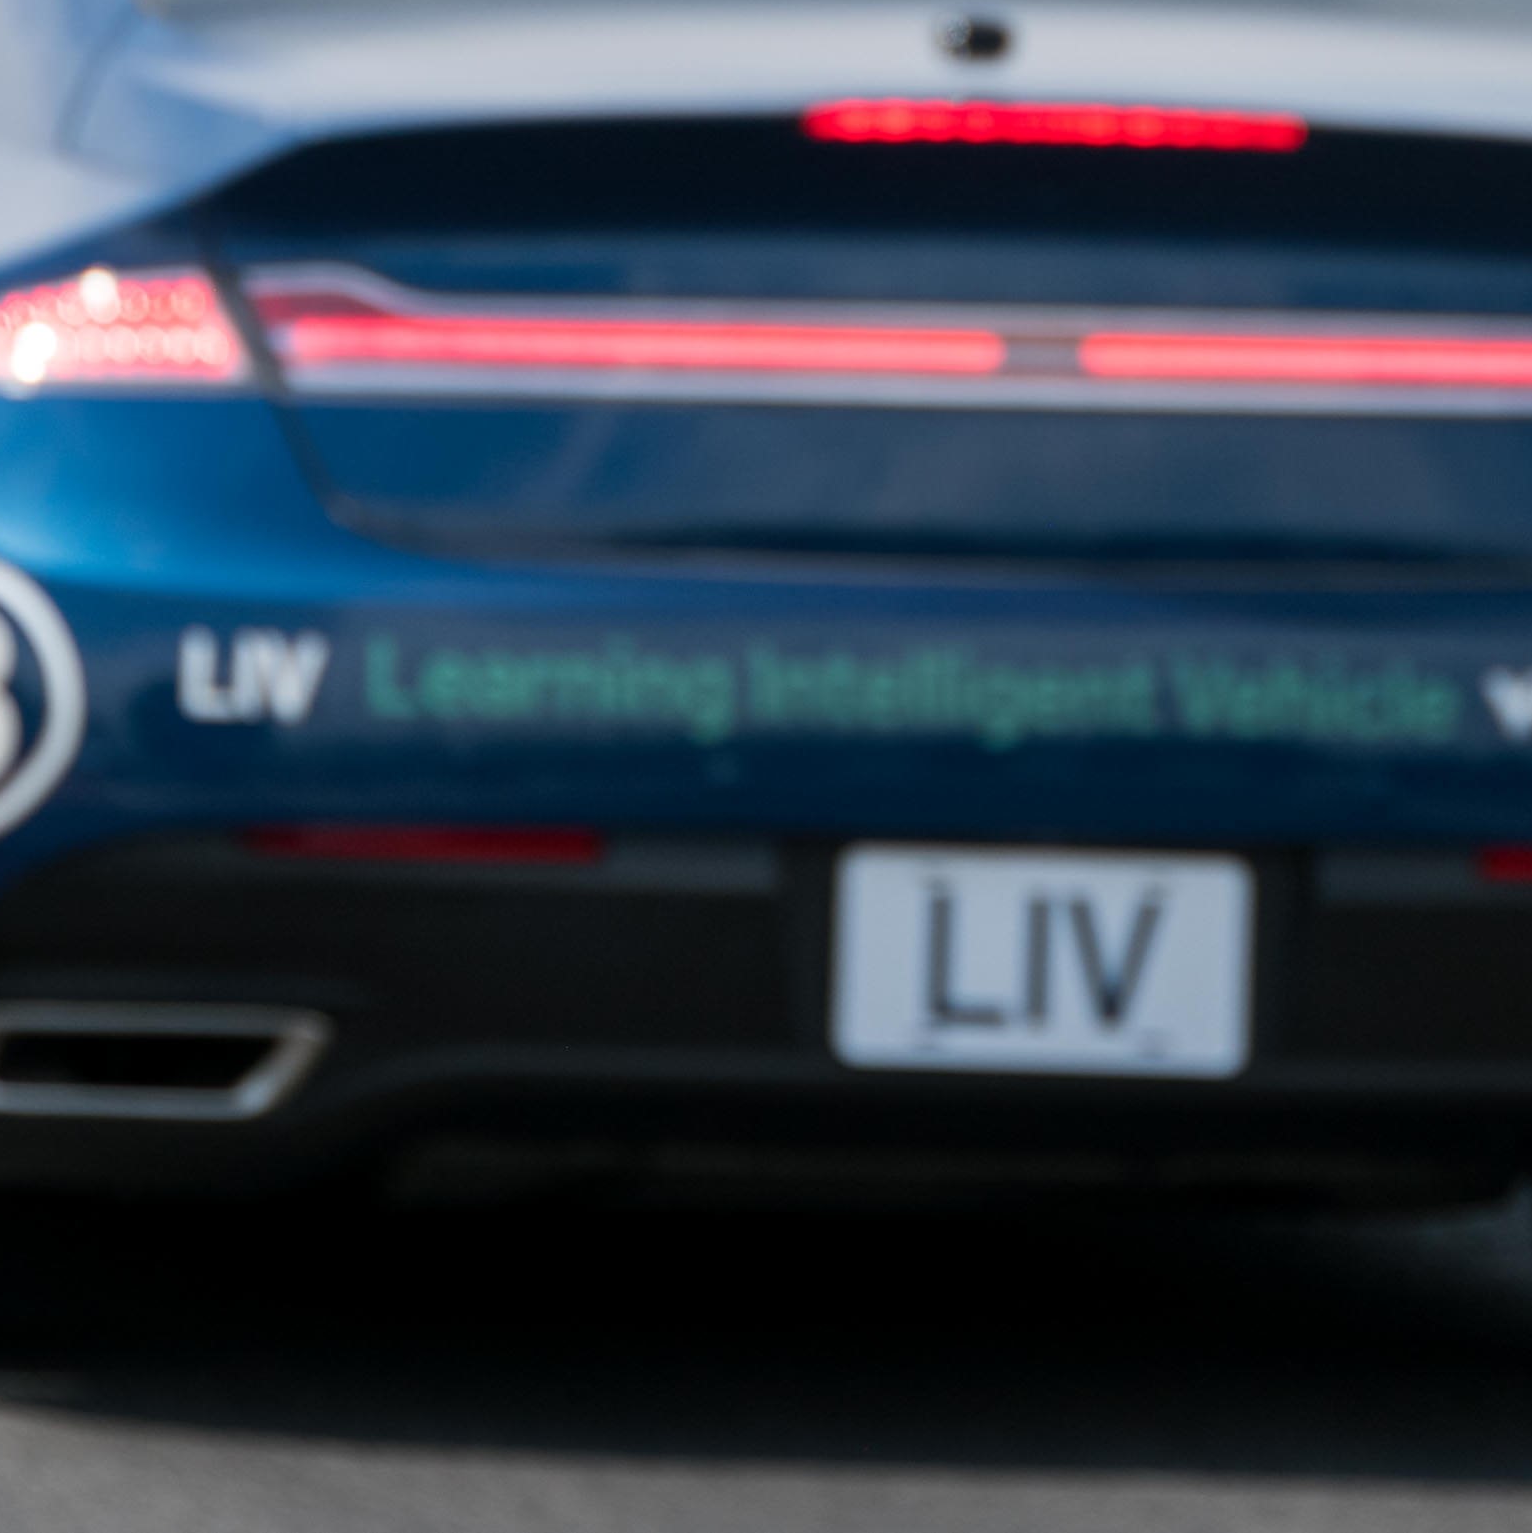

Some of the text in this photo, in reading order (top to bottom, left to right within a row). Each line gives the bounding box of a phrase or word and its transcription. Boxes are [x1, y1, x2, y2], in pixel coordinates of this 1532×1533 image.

[176, 624, 329, 724] LIV
[364, 628, 737, 745] Learning
[747, 640, 1155, 750] Intelligent
[1169, 650, 1459, 743] Vehicle
[923, 882, 1169, 1032] LIV
